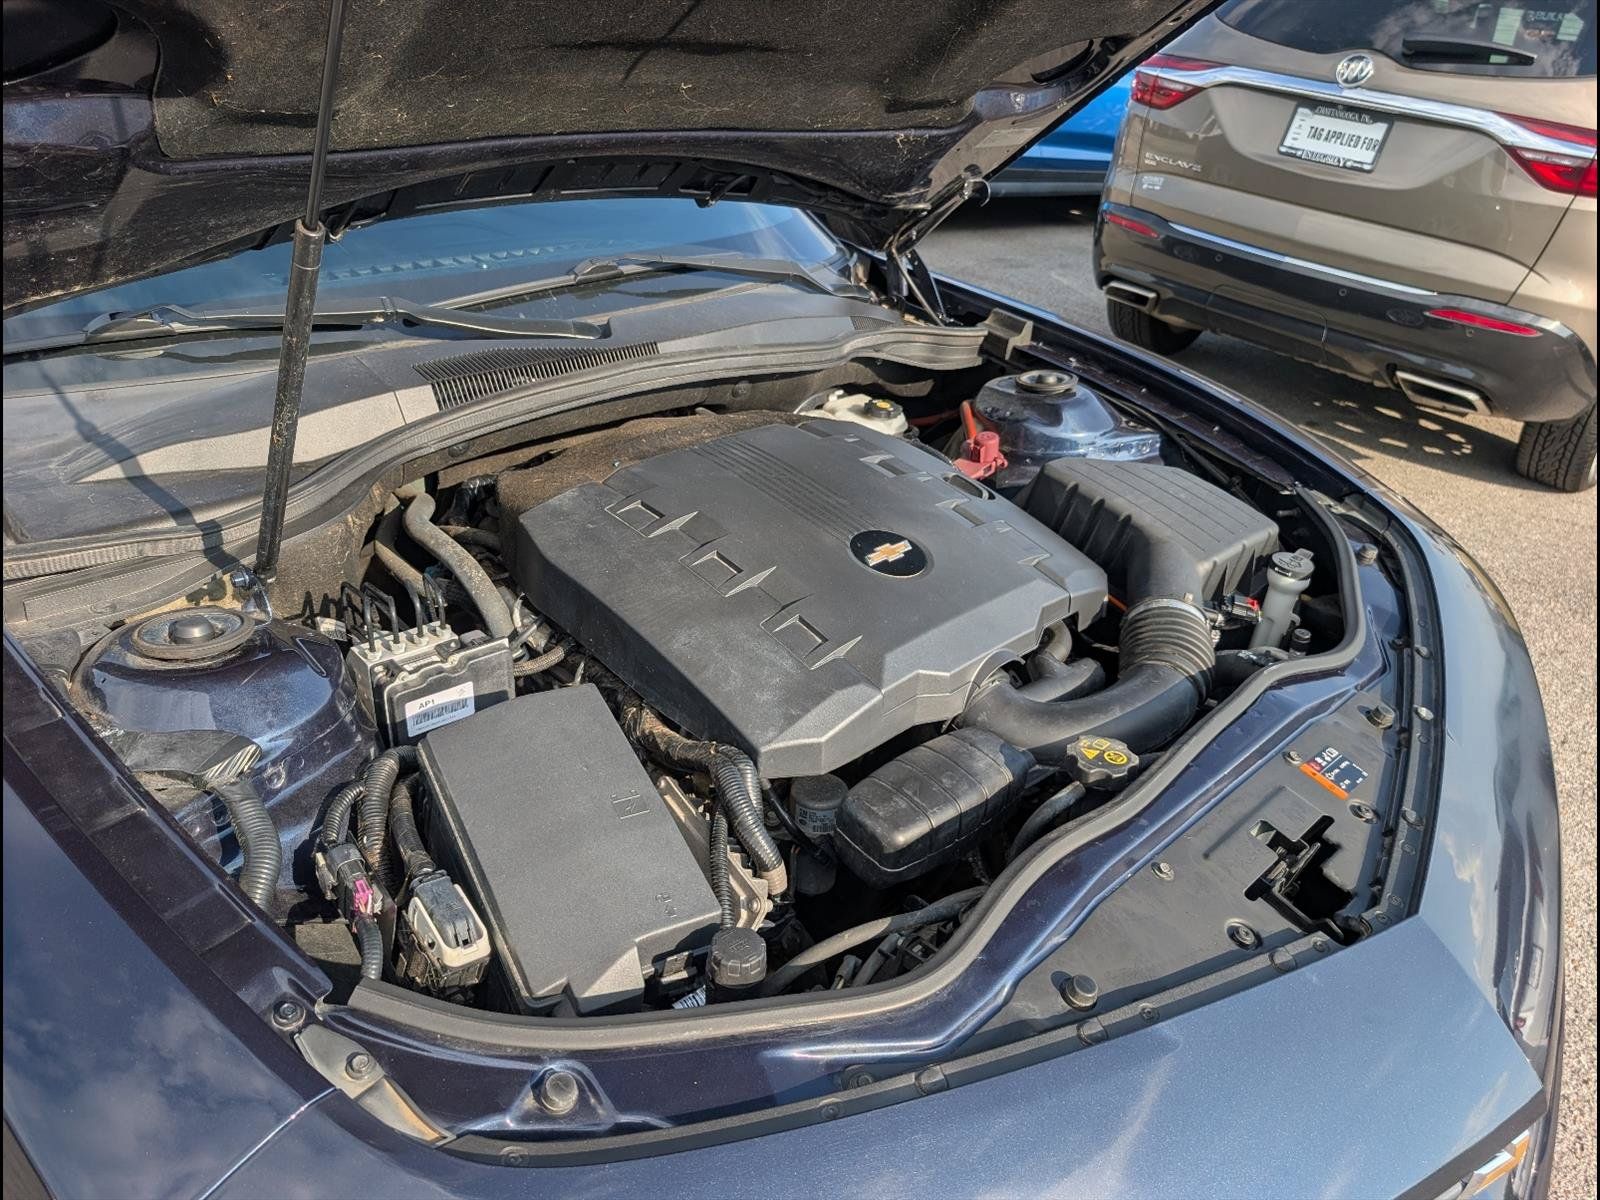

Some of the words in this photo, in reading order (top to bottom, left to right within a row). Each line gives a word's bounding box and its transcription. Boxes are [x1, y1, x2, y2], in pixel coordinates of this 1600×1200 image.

[1307, 126, 1324, 141] TAG
[1324, 129, 1361, 149] APPLIED
[1360, 136, 1380, 152] FOR
[1145, 152, 1202, 172] ENCLAVE
